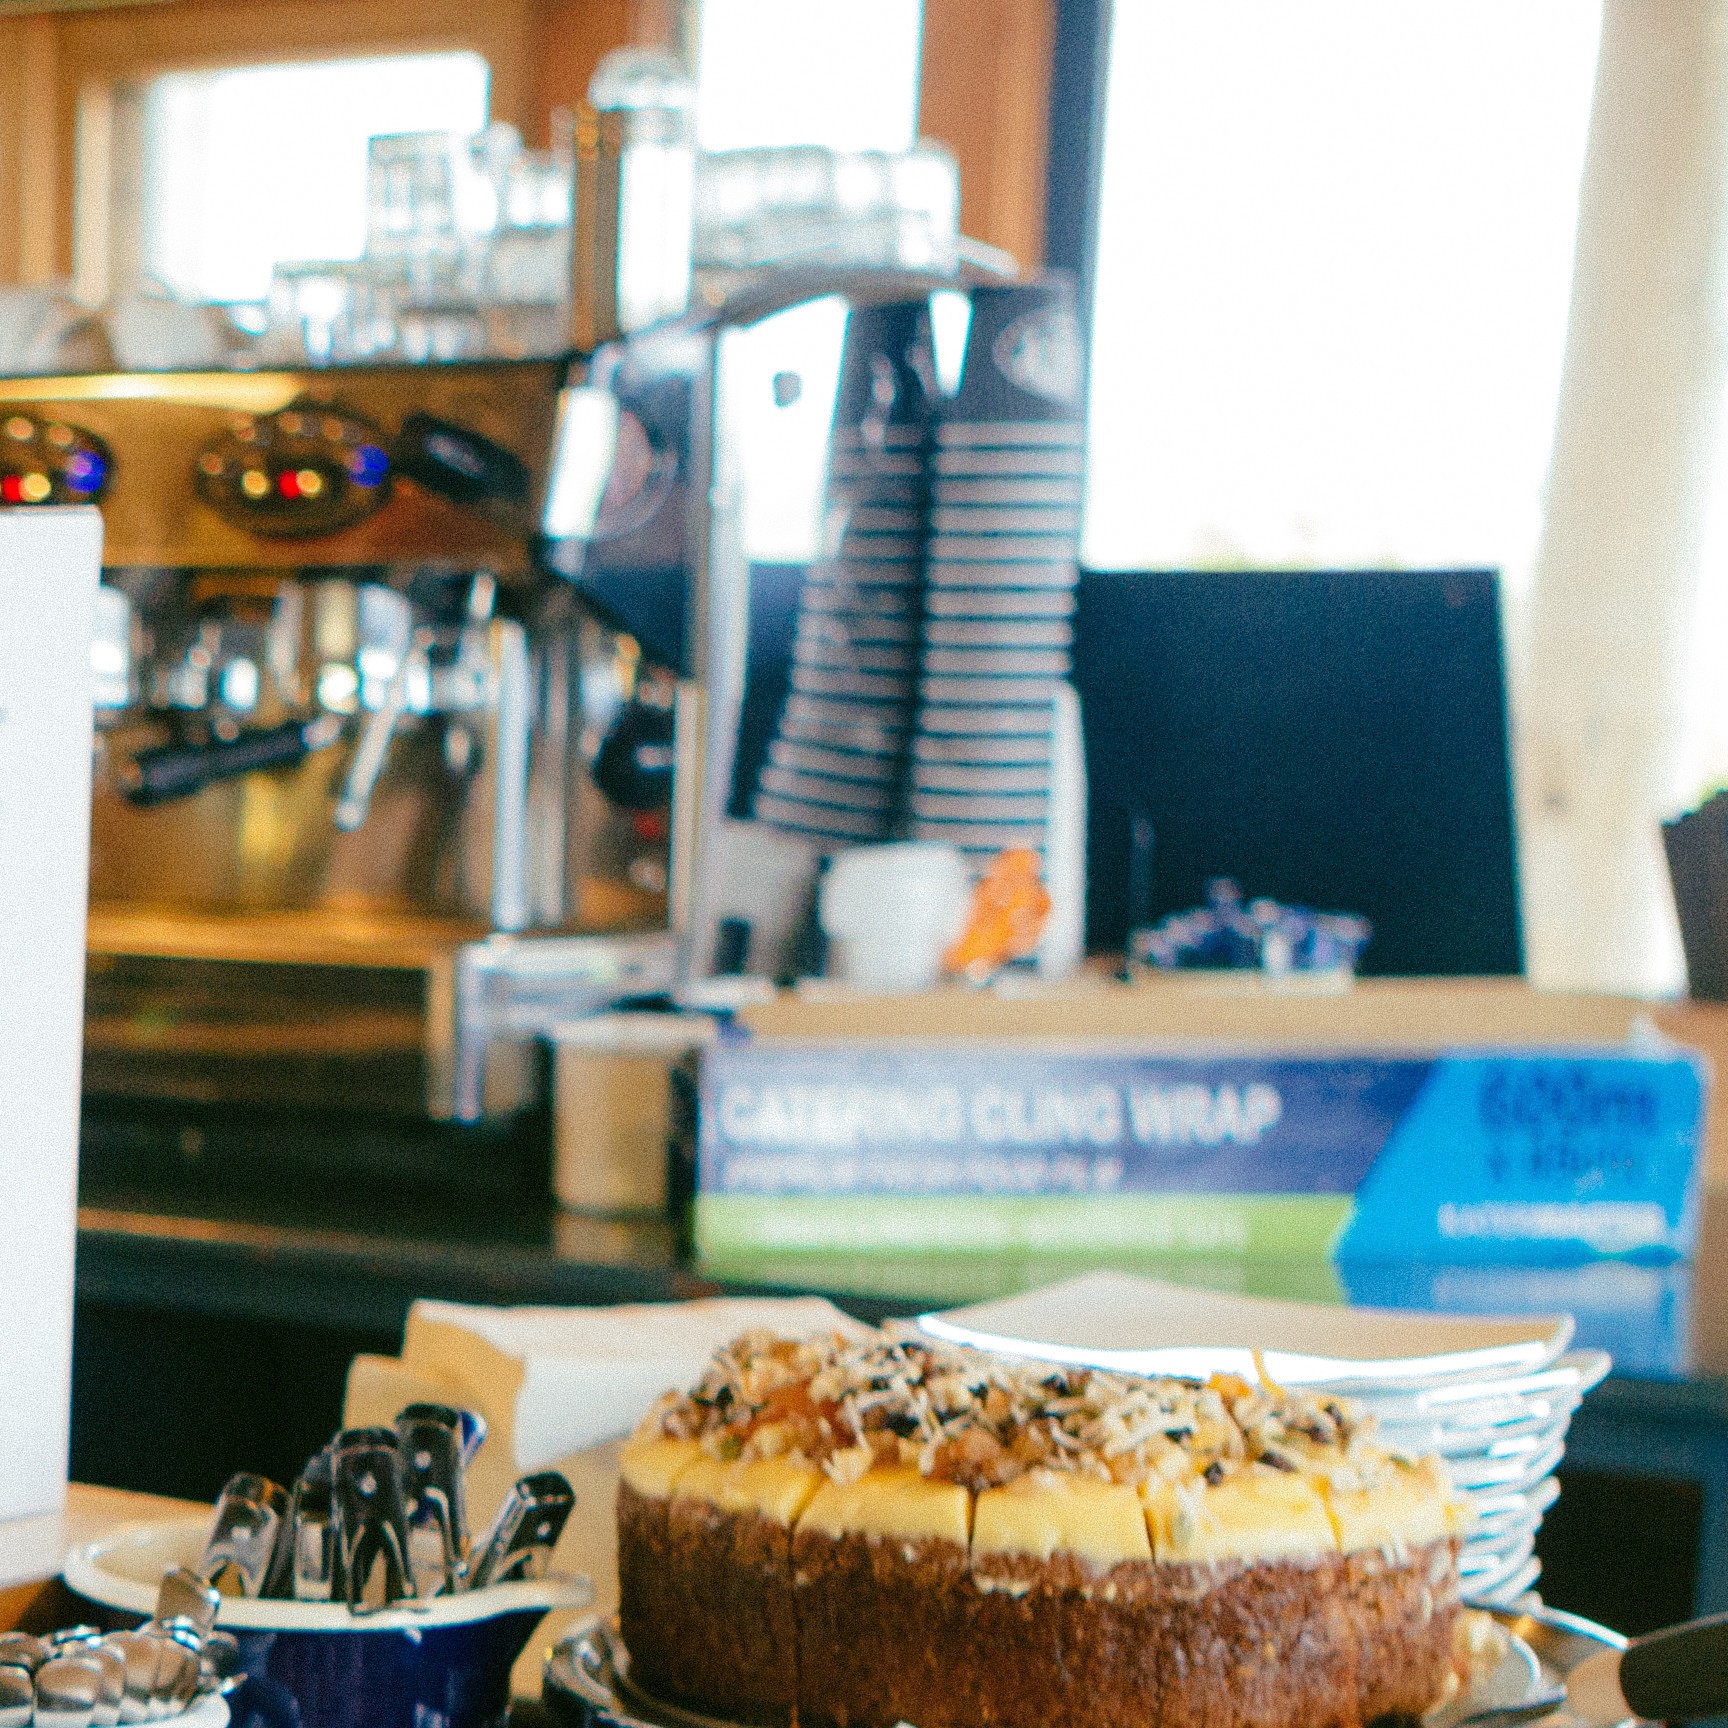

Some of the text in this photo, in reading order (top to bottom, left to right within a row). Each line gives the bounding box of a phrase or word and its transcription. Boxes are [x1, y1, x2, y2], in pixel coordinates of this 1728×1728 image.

[718, 1080, 1283, 1148] CATERING CLING WRAP
